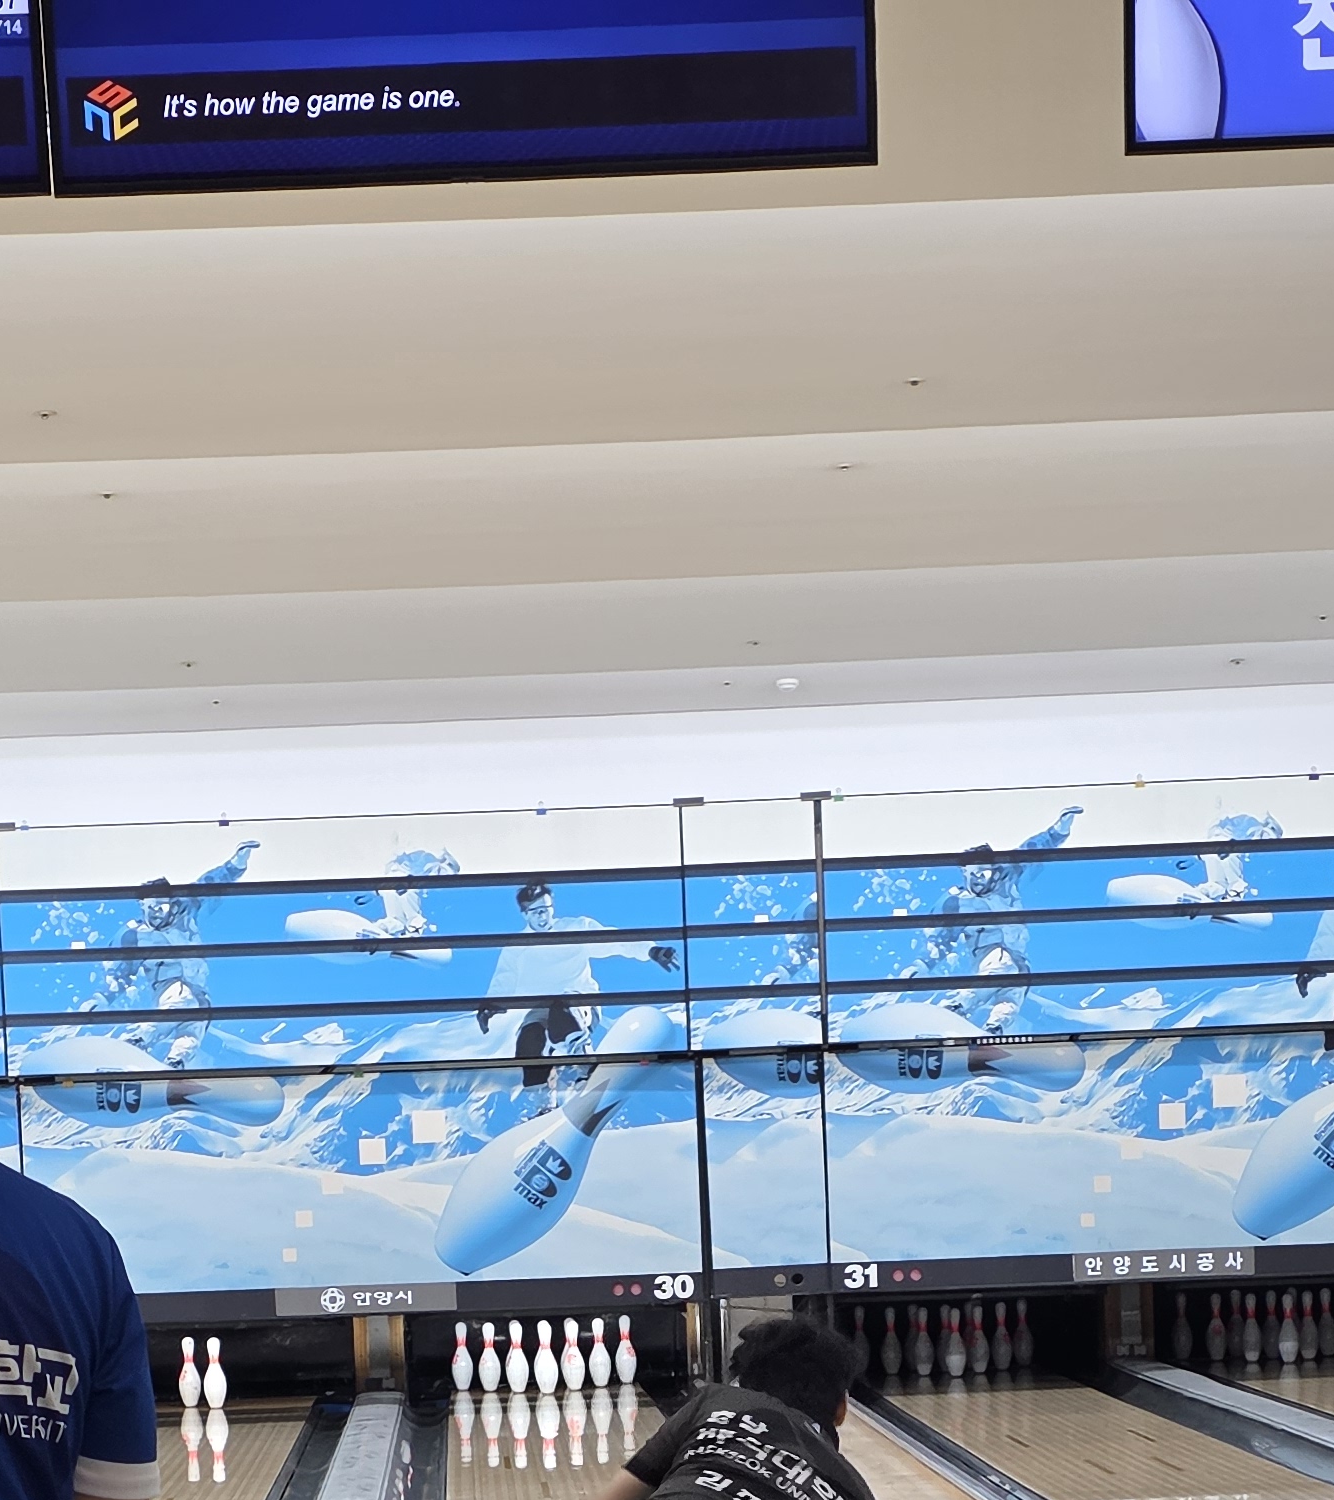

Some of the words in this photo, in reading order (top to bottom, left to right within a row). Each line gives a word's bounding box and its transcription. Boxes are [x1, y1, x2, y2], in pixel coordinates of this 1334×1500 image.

[163, 91, 197, 118] It's
[203, 91, 257, 117] how
[261, 90, 301, 115] the
[307, 90, 375, 119] game
[382, 86, 402, 110] is
[408, 86, 462, 110] one.
[513, 1182, 548, 1210] max
[654, 1275, 695, 1299] 30
[843, 1264, 879, 1289] 31
[352, 1290, 414, 1306] 안양시
